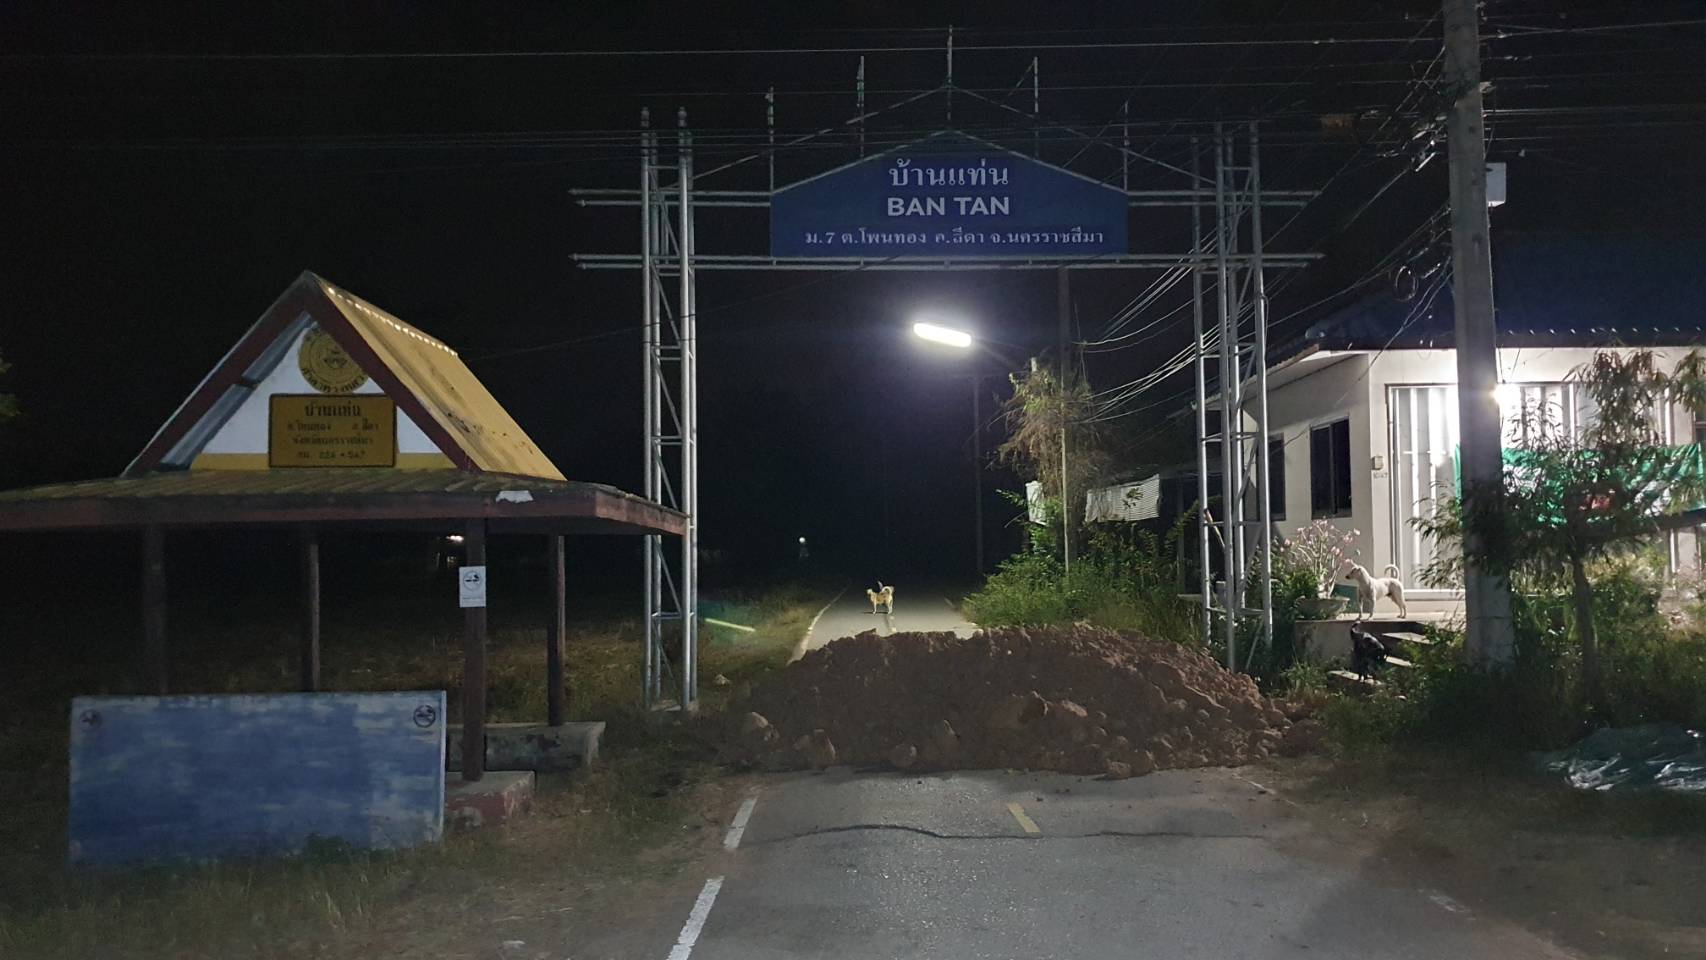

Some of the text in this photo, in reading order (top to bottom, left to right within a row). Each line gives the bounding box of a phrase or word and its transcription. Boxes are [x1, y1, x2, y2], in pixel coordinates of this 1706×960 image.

[888, 158, 1009, 186] บ้านแท่น
[887, 196, 1010, 217] BAN TAN
[990, 226, 1104, 244] จ.นครราชสีมา
